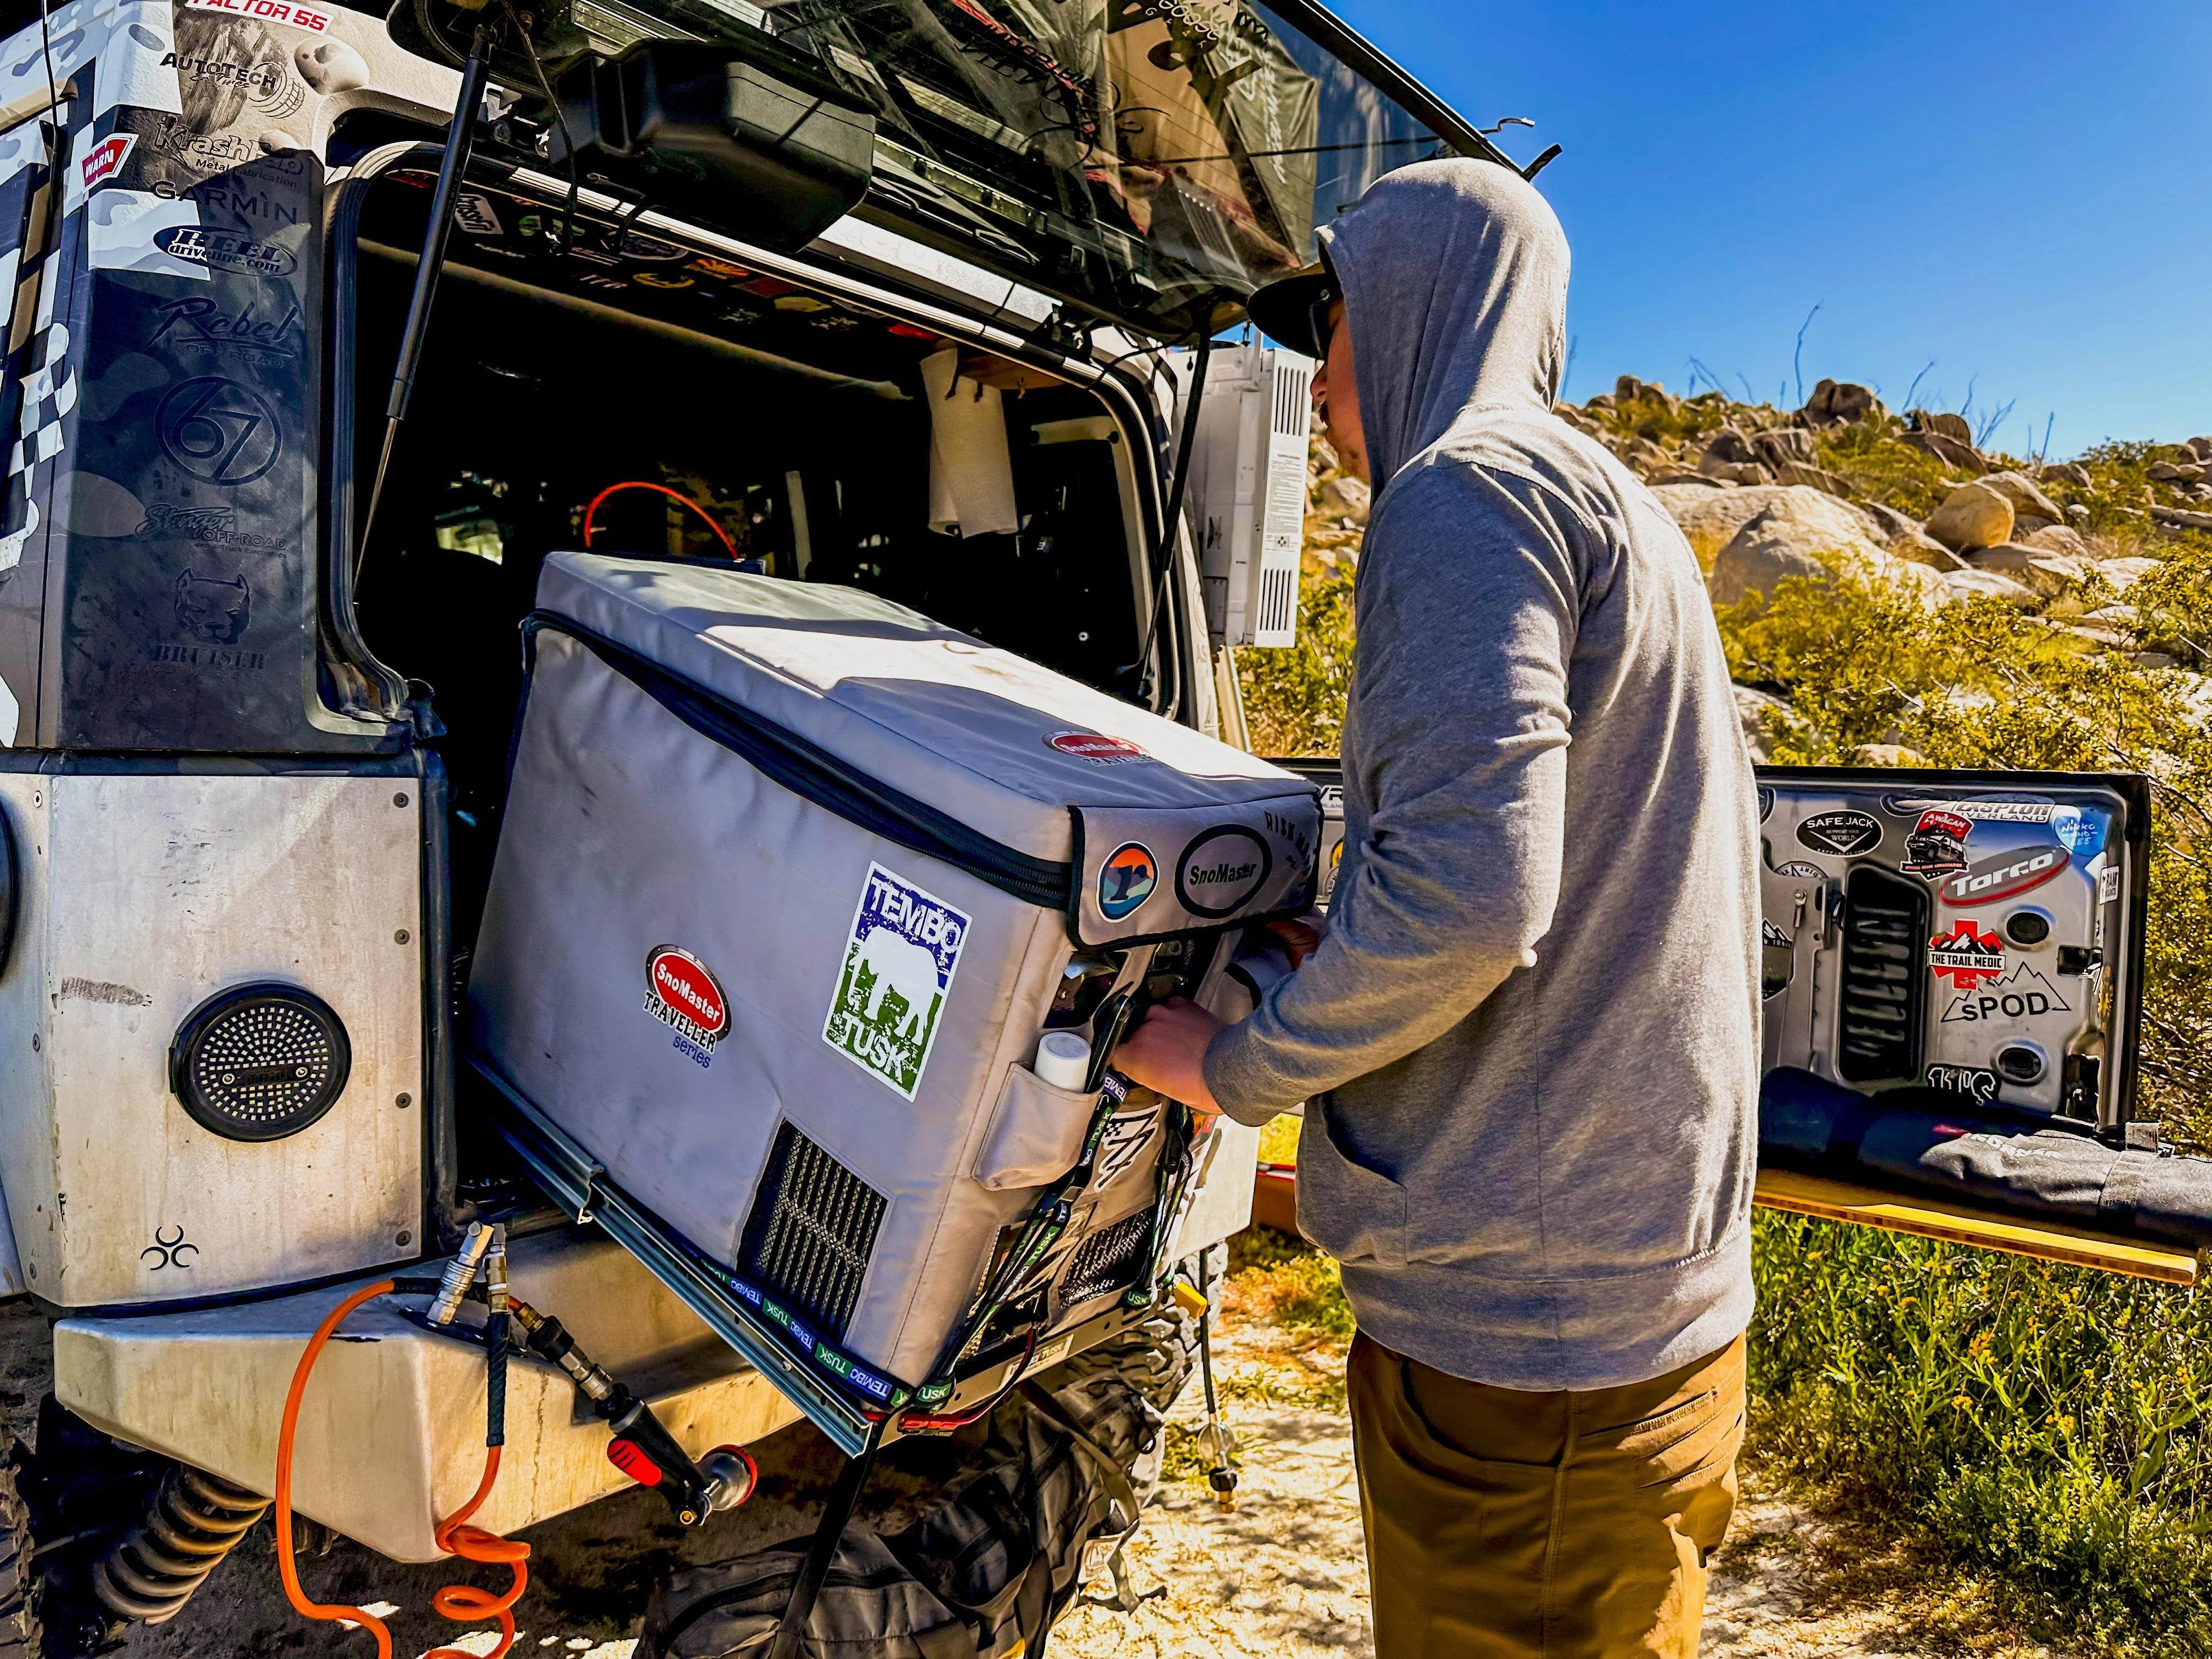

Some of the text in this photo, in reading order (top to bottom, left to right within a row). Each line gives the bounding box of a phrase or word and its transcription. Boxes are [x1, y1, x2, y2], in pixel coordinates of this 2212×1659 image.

[293, 9, 328, 31] 55
[160, 53, 276, 89] AUTOTECH
[83, 149, 115, 179] WARN
[196, 159, 230, 172] Metal
[151, 179, 298, 225] GARMIN
[146, 296, 299, 347] Rebel
[187, 343, 283, 368] OFF ROAD
[202, 529, 288, 550] OFF-ROAD
[1807, 817, 1874, 829] SAFE JACK
[1189, 863, 1257, 886] SnoMaster
[1951, 850, 2051, 897] Torco
[870, 876, 962, 955] TEMBO
[1931, 953, 2002, 968] THE TRAIL MEDIC
[657, 963, 720, 1023] SnoMaster
[1962, 991, 2050, 1021] sPOD
[644, 991, 716, 1054] TRAVELLER
[673, 1036, 712, 1069] series
[841, 1012, 910, 1084] TUSK
[1104, 1076, 1126, 1103] TEMB
[1029, 1232, 1057, 1261] TUSK
[730, 1280, 761, 1305] TEMBO
[766, 1301, 789, 1327] TUSK
[790, 1321, 814, 1350] TEMBO
[819, 1346, 846, 1374] TUSK
[849, 1367, 889, 1398] TEMBO
